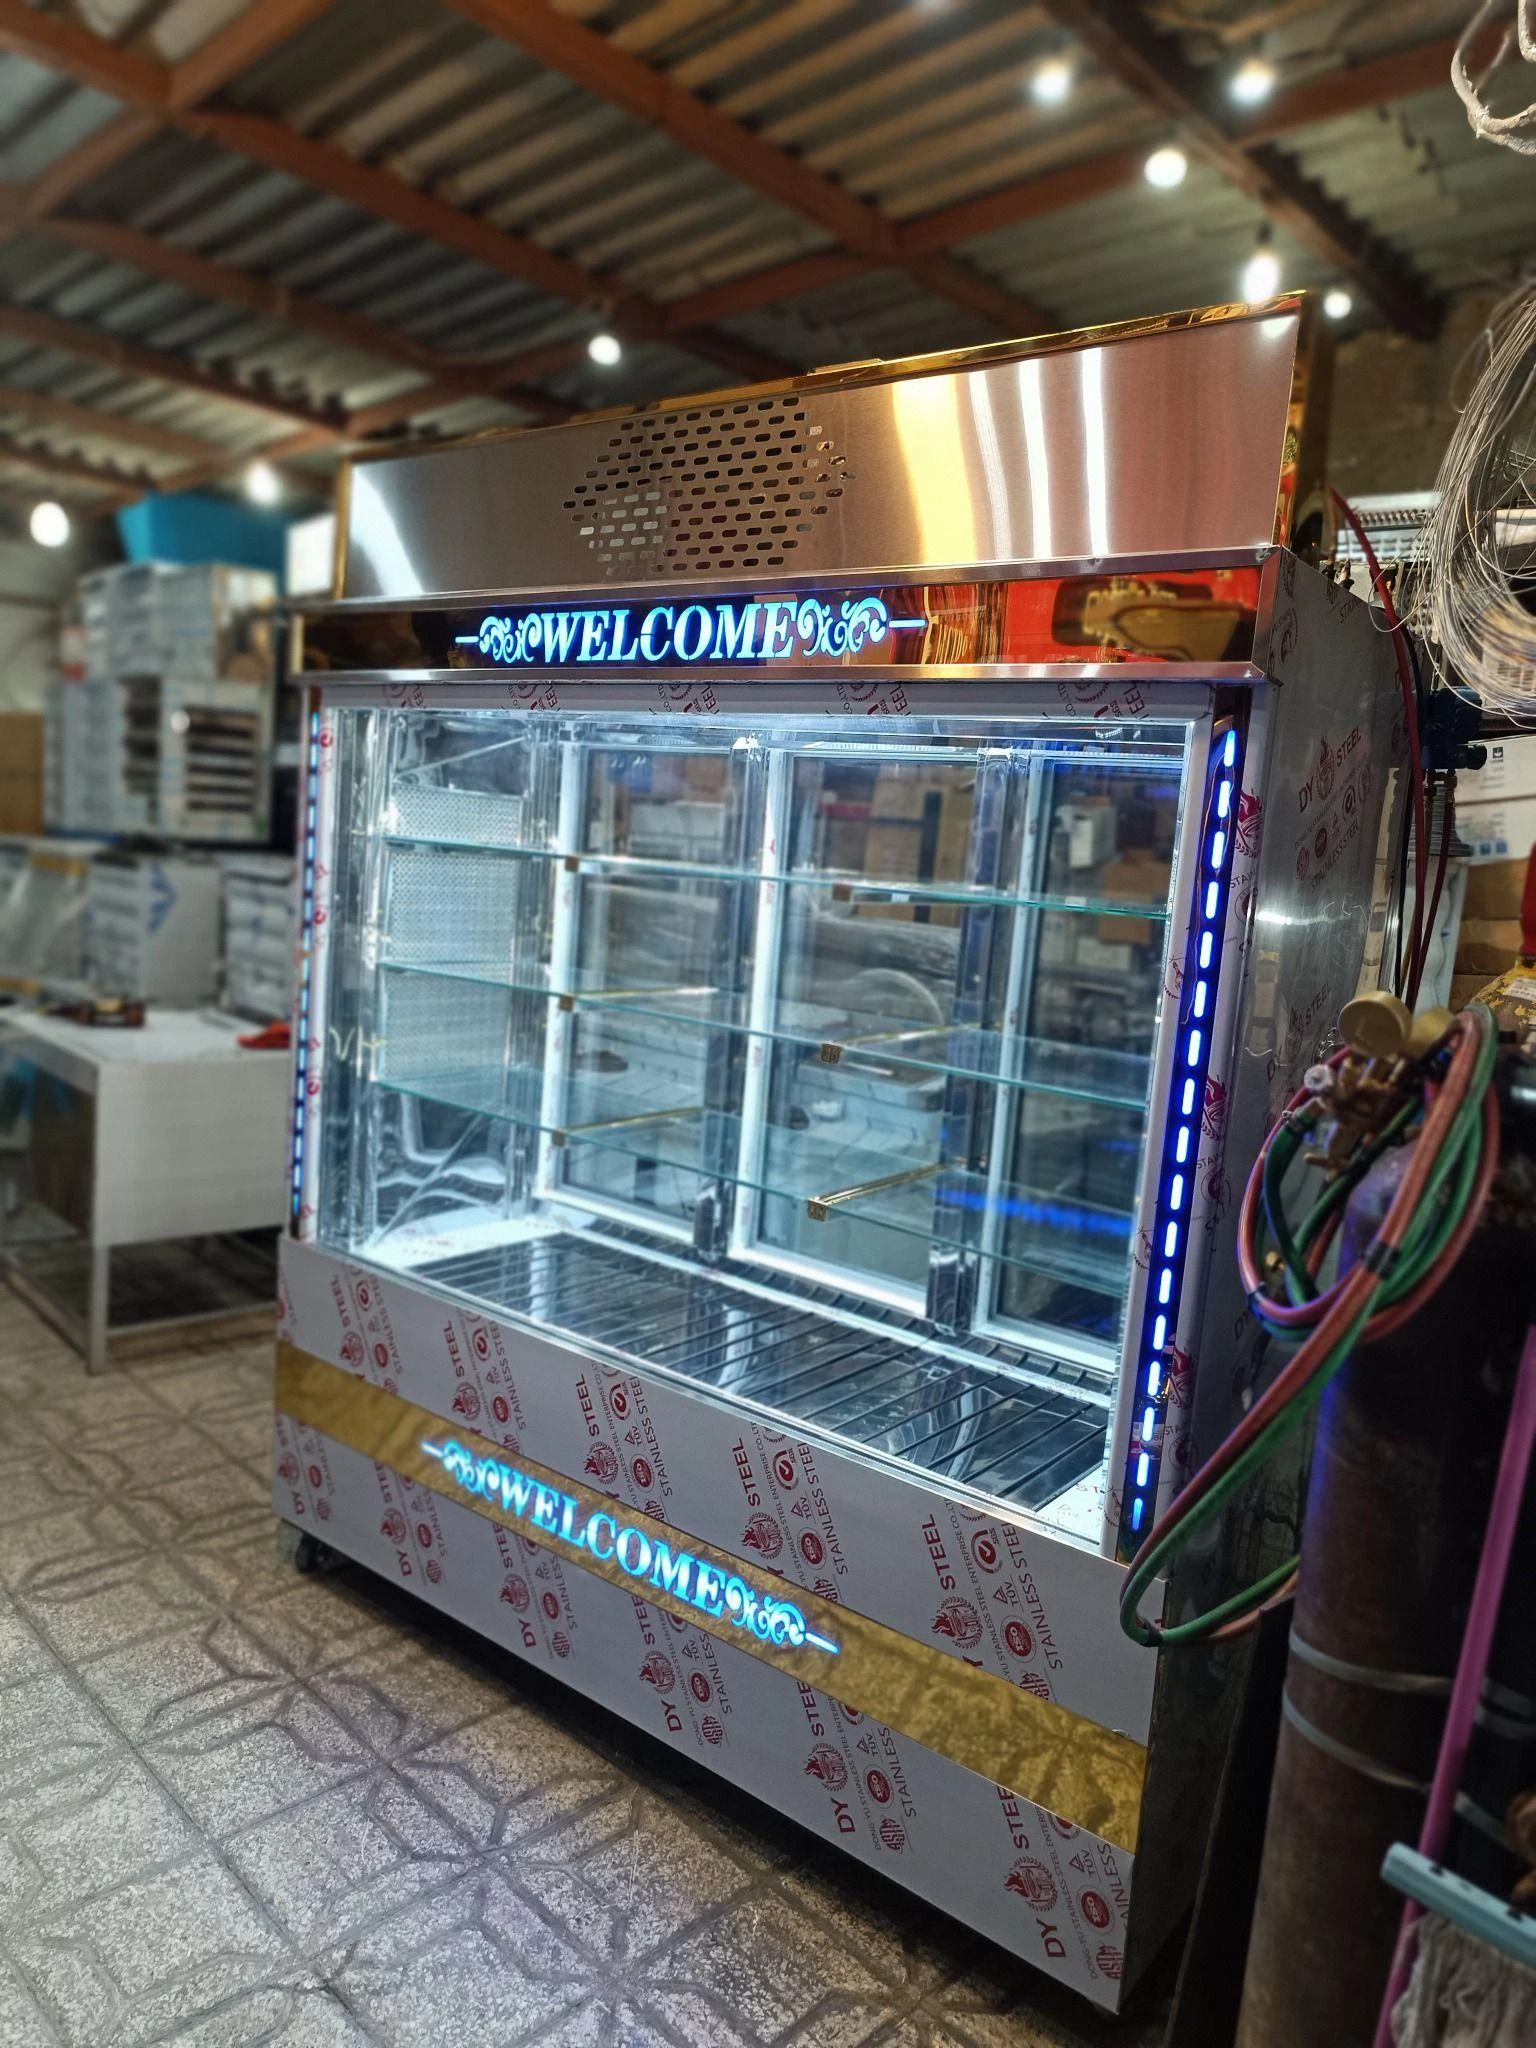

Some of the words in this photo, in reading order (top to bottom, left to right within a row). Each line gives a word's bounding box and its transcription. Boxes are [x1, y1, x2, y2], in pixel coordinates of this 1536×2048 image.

[538, 601, 798, 663] WELCOME
[1299, 776, 1314, 812] DY
[1336, 726, 1361, 766] STEEL
[1306, 983, 1331, 1025] STEEL
[332, 1274, 350, 1327] STEEL
[444, 1320, 465, 1377] STEEL
[500, 1358, 526, 1430] STAINLESS
[576, 1374, 600, 1437] STEEL
[374, 1462, 392, 1503] STEE
[641, 1417, 673, 1496] STAINLESS
[732, 1438, 760, 1507] STEEL
[499, 1462, 727, 1617] WELCOME
[776, 1502, 787, 1524] STEEL
[812, 1488, 848, 1575] STAINLESS
[396, 1550, 412, 1576] DY
[492, 1522, 513, 1568] STEE
[784, 1526, 801, 1569] STAINLESS
[922, 1514, 956, 1590] STEEL
[955, 1531, 978, 1583] ENTERPRISE
[550, 1554, 577, 1630] STAINLESS
[975, 1586, 988, 1611] STEEL
[1004, 1582, 1019, 1607] TÜV
[518, 1619, 536, 1648] DY
[631, 1595, 655, 1645] STEE
[983, 1613, 1005, 1661] STAINLESS
[1018, 1573, 1063, 1670] STAINLESS
[699, 1632, 732, 1714] STAINLESS
[661, 1700, 682, 1732] DY
[796, 1682, 824, 1736] STEE
[878, 1727, 917, 1818] STAINLESS
[830, 1797, 856, 1833] DY
[879, 1818, 905, 1851] ASTM
[996, 1786, 1030, 1850] STEE
[1081, 1849, 1096, 1876] TÜV
[1097, 1843, 1128, 1925] AINLESS
[1036, 1918, 1067, 1958] DY
